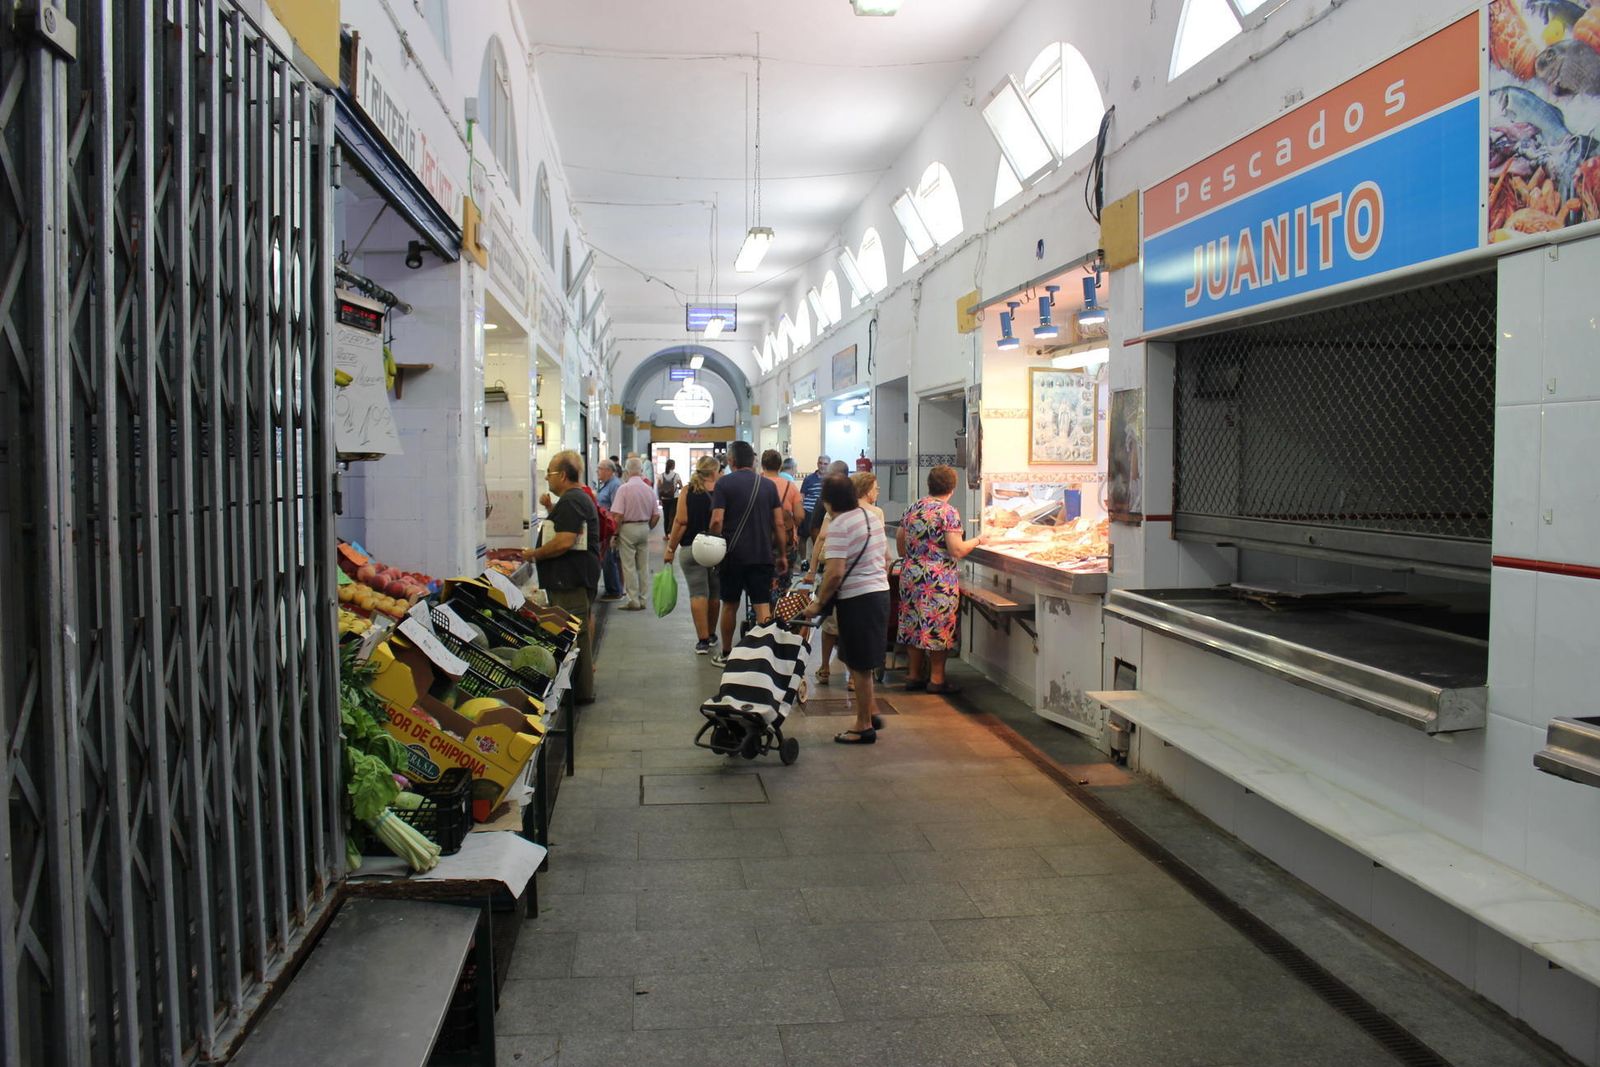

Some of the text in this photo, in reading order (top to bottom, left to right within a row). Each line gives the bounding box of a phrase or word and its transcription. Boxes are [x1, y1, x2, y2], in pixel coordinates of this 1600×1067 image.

[1174, 79, 1406, 215] Pescados
[1185, 180, 1384, 309] JUANITO
[411, 724, 431, 743] DE
[430, 735, 486, 777] CHIPIONA
